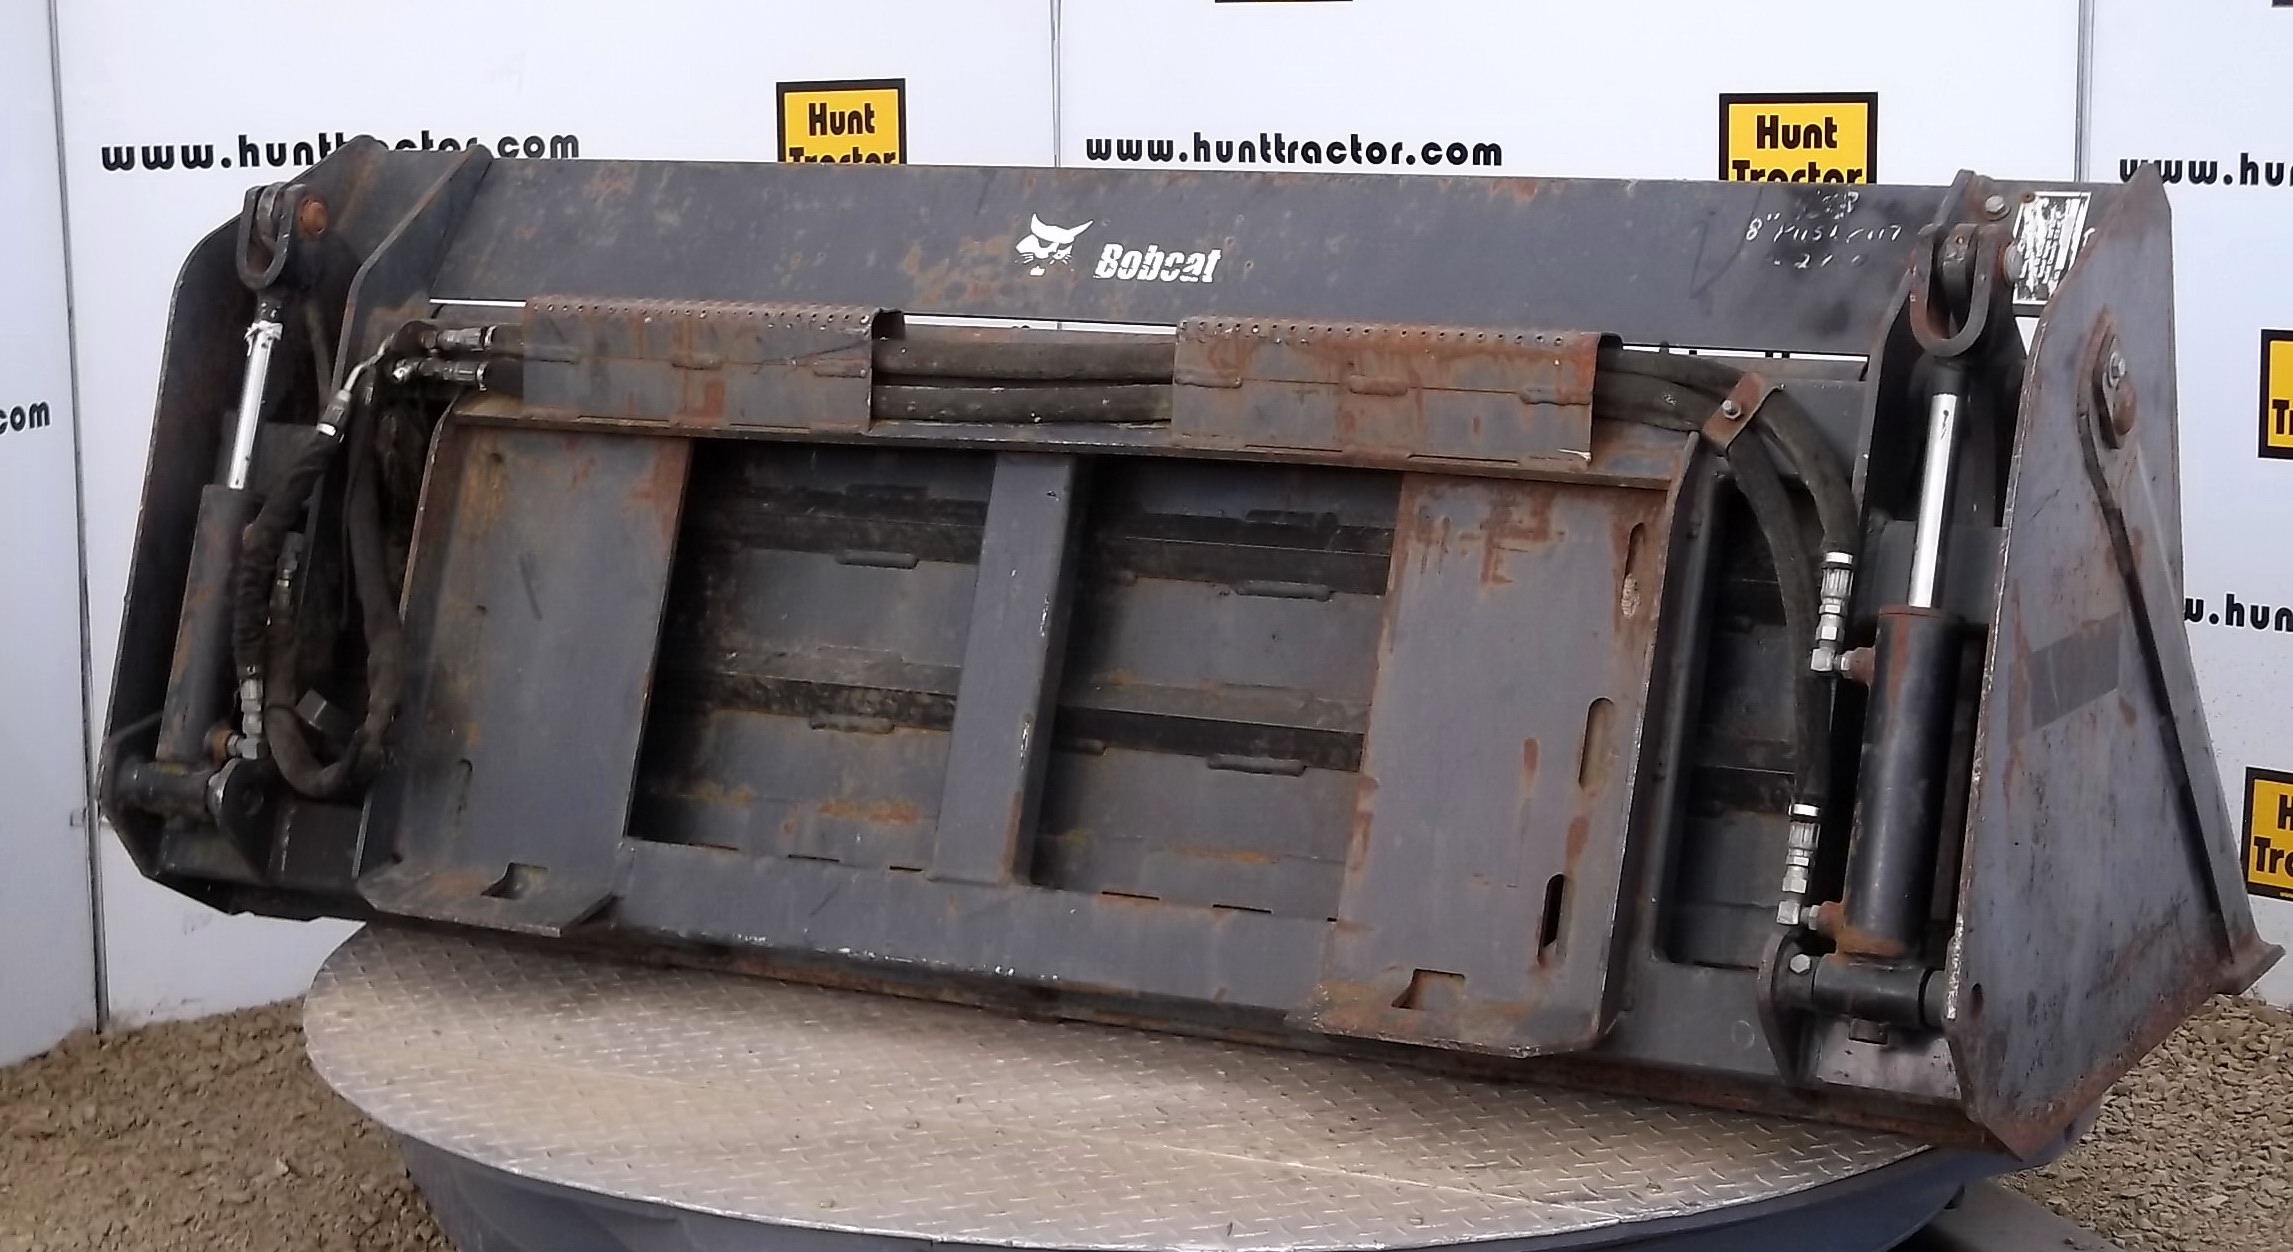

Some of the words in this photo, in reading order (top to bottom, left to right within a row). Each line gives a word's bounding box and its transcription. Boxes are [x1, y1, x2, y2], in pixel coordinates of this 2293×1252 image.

[808, 102, 875, 136] Hunt
[1756, 115, 1837, 149] Hunt
[1086, 132, 1502, 166] www.hunttractor.com
[1093, 243, 1222, 283] Bobcat
